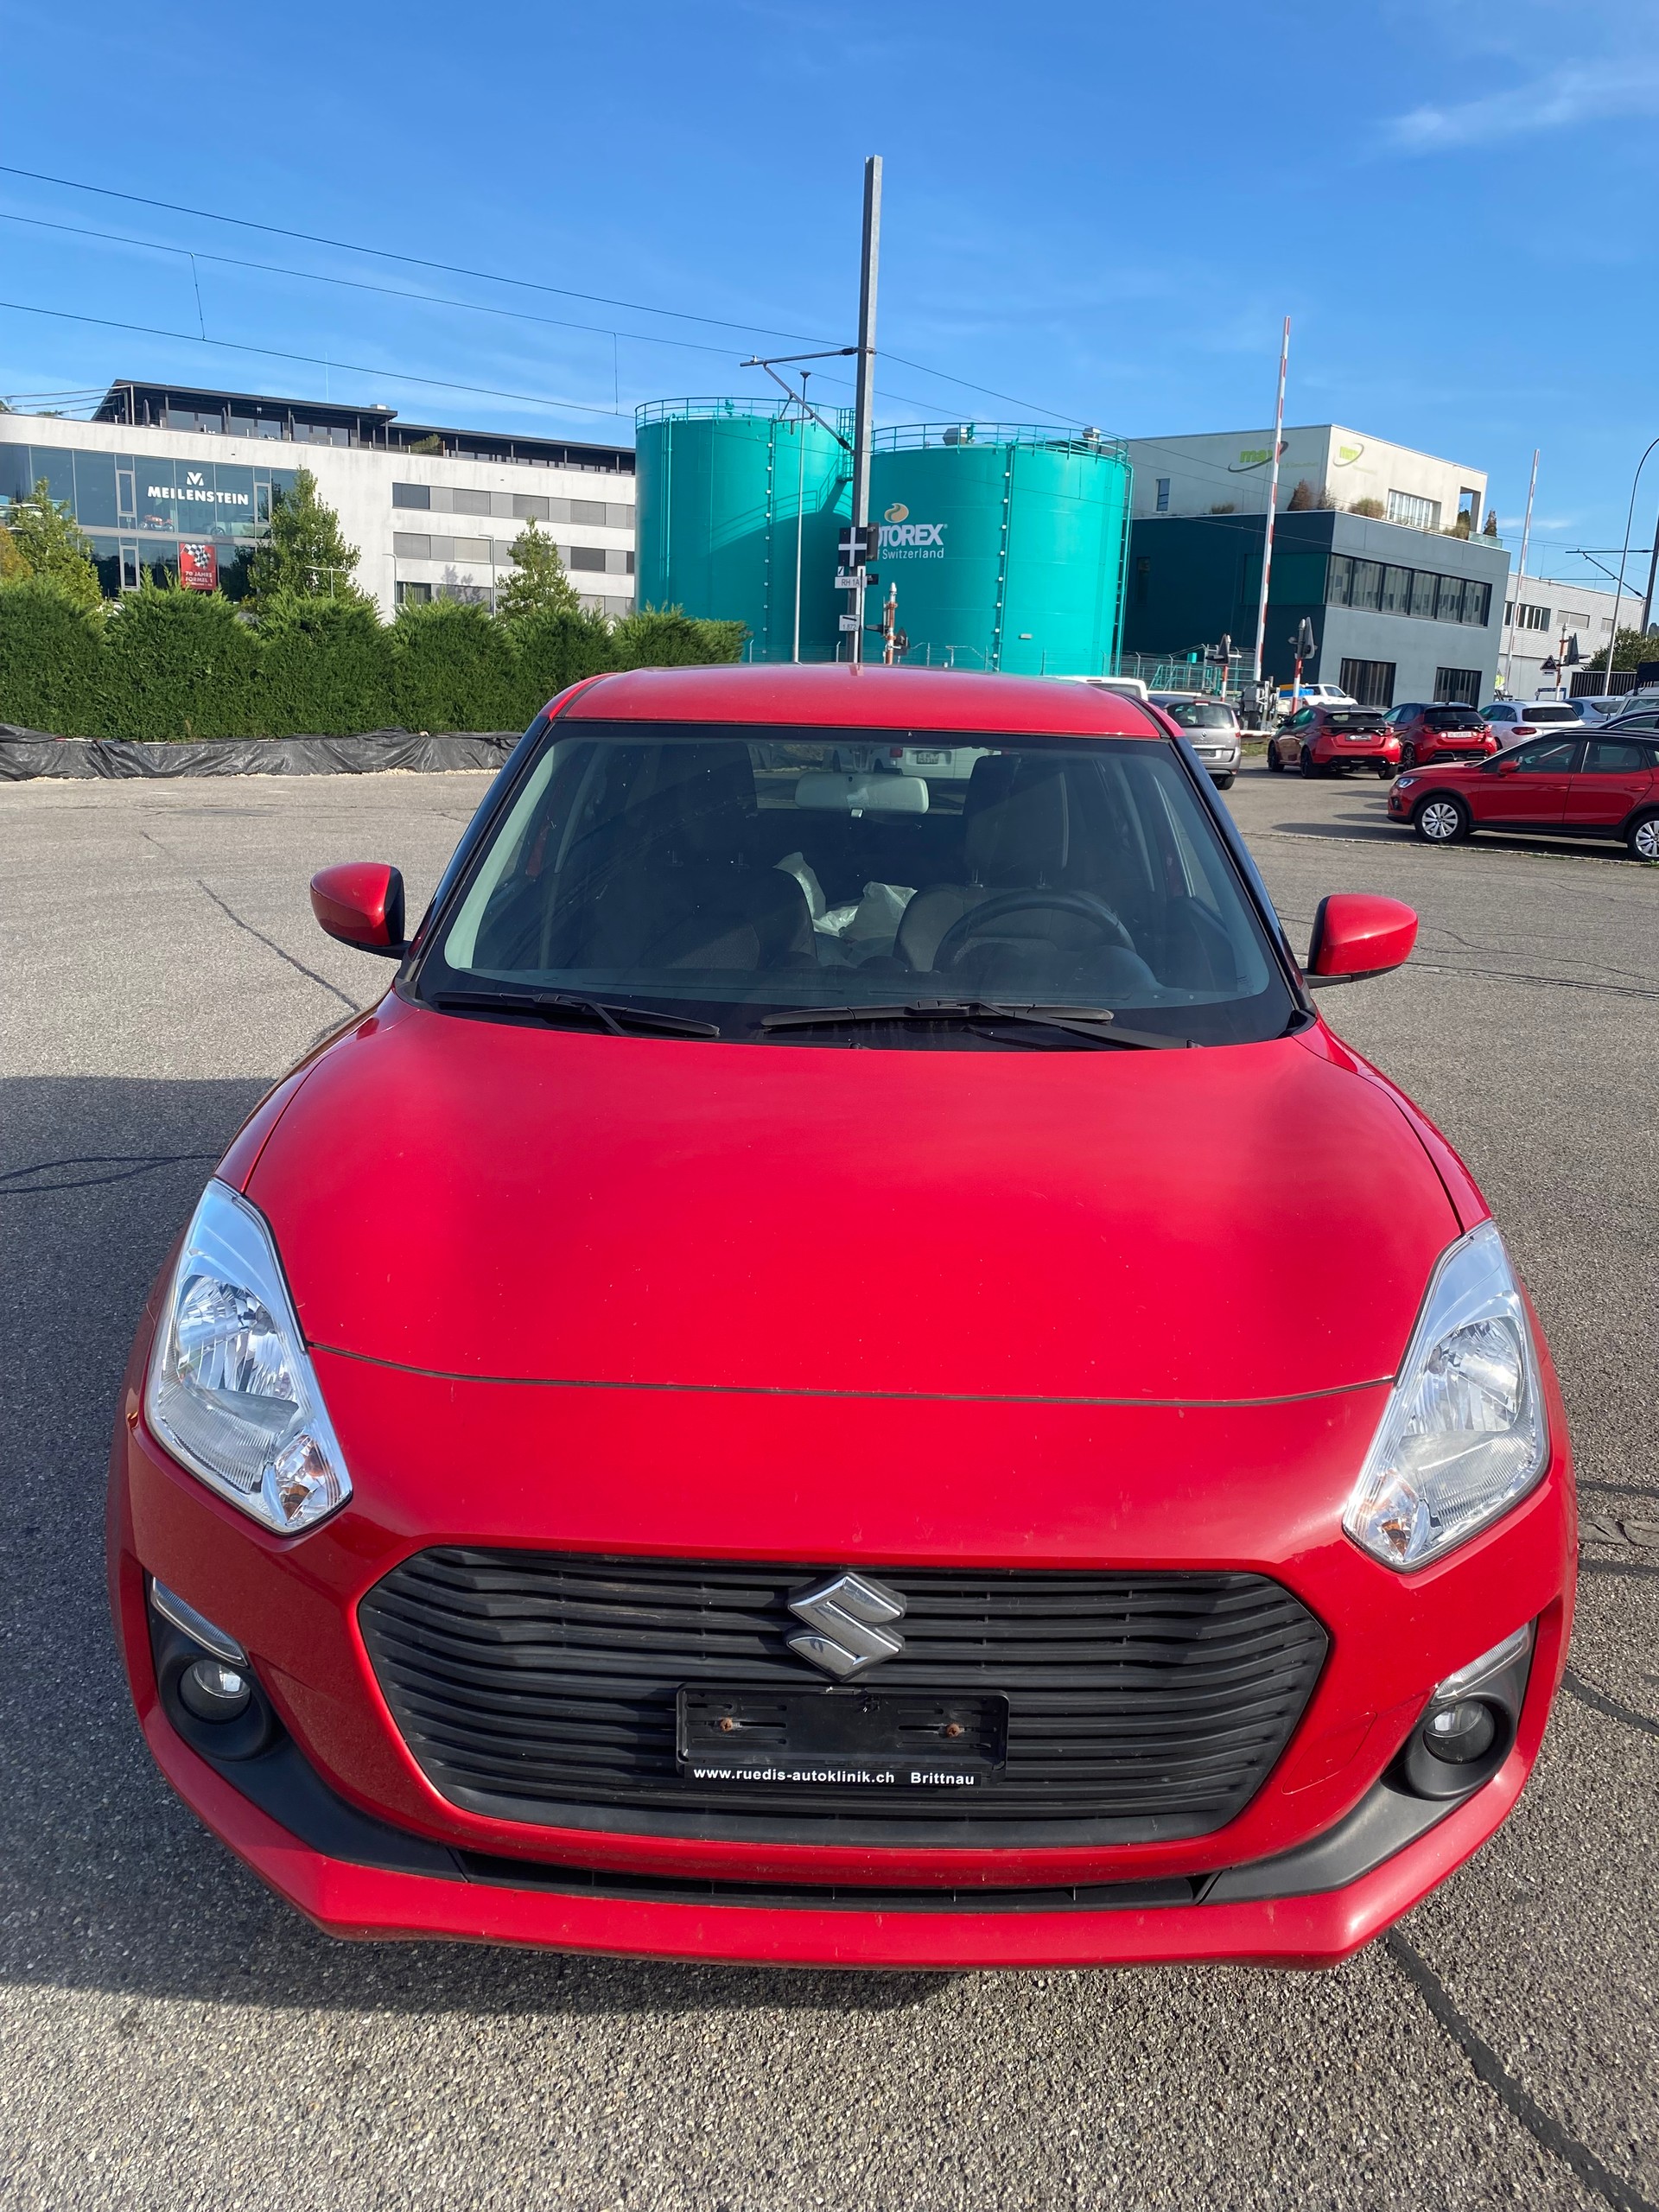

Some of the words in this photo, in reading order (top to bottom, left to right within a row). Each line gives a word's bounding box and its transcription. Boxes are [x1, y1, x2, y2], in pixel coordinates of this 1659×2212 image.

[148, 486, 249, 505] MEILENSTEIN
[878, 524, 944, 547] TOREX
[882, 548, 944, 560] Switzerland
[693, 1767, 895, 1783] www.ruedis-autoklinik.ch
[910, 1772, 975, 1786] Brittnau
